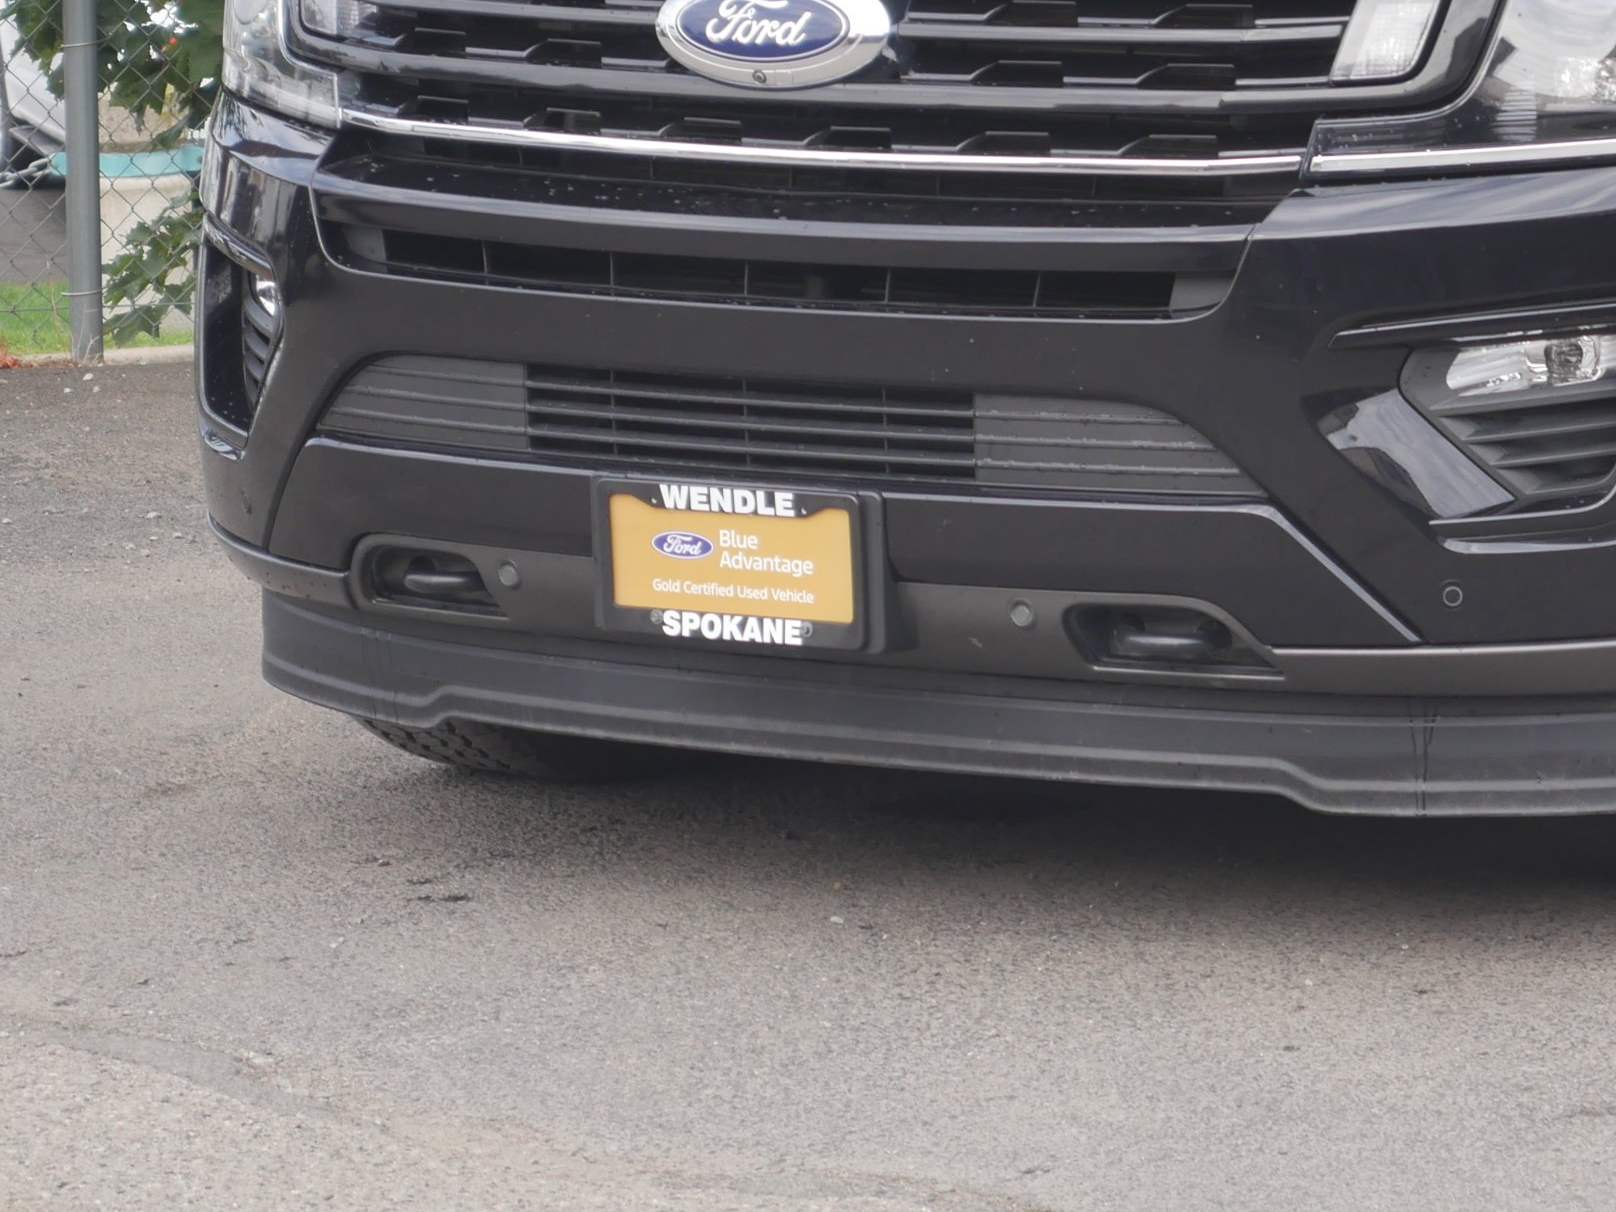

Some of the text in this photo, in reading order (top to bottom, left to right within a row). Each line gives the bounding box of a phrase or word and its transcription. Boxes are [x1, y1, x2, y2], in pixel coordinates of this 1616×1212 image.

[658, 483, 796, 518] WENDLE
[662, 533, 703, 556] Ford
[719, 529, 759, 550] Blue
[719, 551, 814, 577] Advantage
[652, 578, 815, 604] Gold Certified Used Vehicle
[662, 609, 803, 646] SPOKANE
